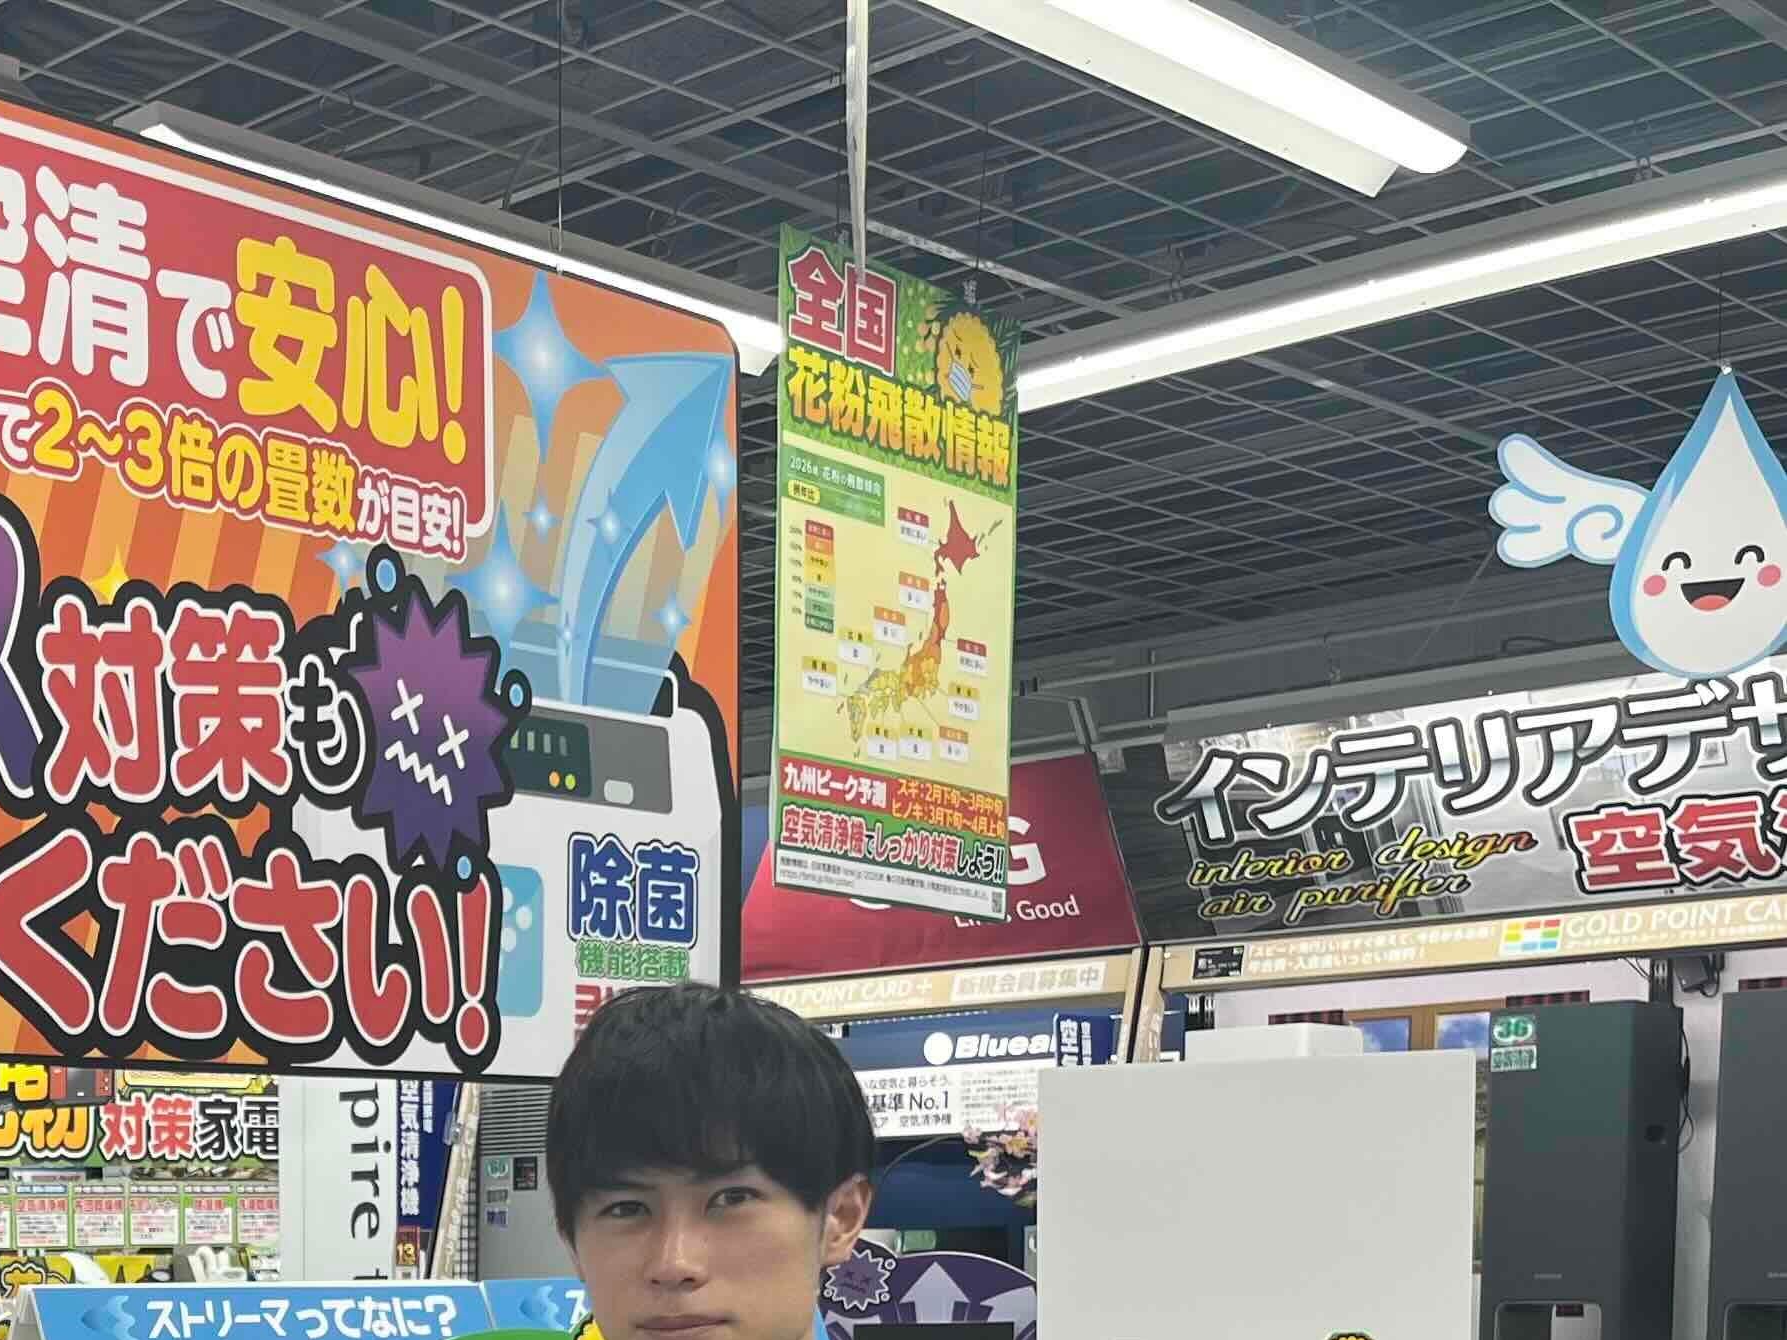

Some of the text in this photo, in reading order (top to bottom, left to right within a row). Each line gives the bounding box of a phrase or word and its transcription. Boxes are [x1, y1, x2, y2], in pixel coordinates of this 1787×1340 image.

[787, 245, 898, 378] 全国
[787, 343, 1012, 488] 花粉飛散情報
[783, 762, 888, 810] 九州ピーク予測
[567, 831, 701, 948] 除菌
[1187, 825, 1539, 890] interior design
[1016, 894, 1081, 922] Good
[1196, 860, 1472, 926] air purifier
[573, 938, 692, 984] 機能搭載
[908, 1091, 950, 1113] No.1
